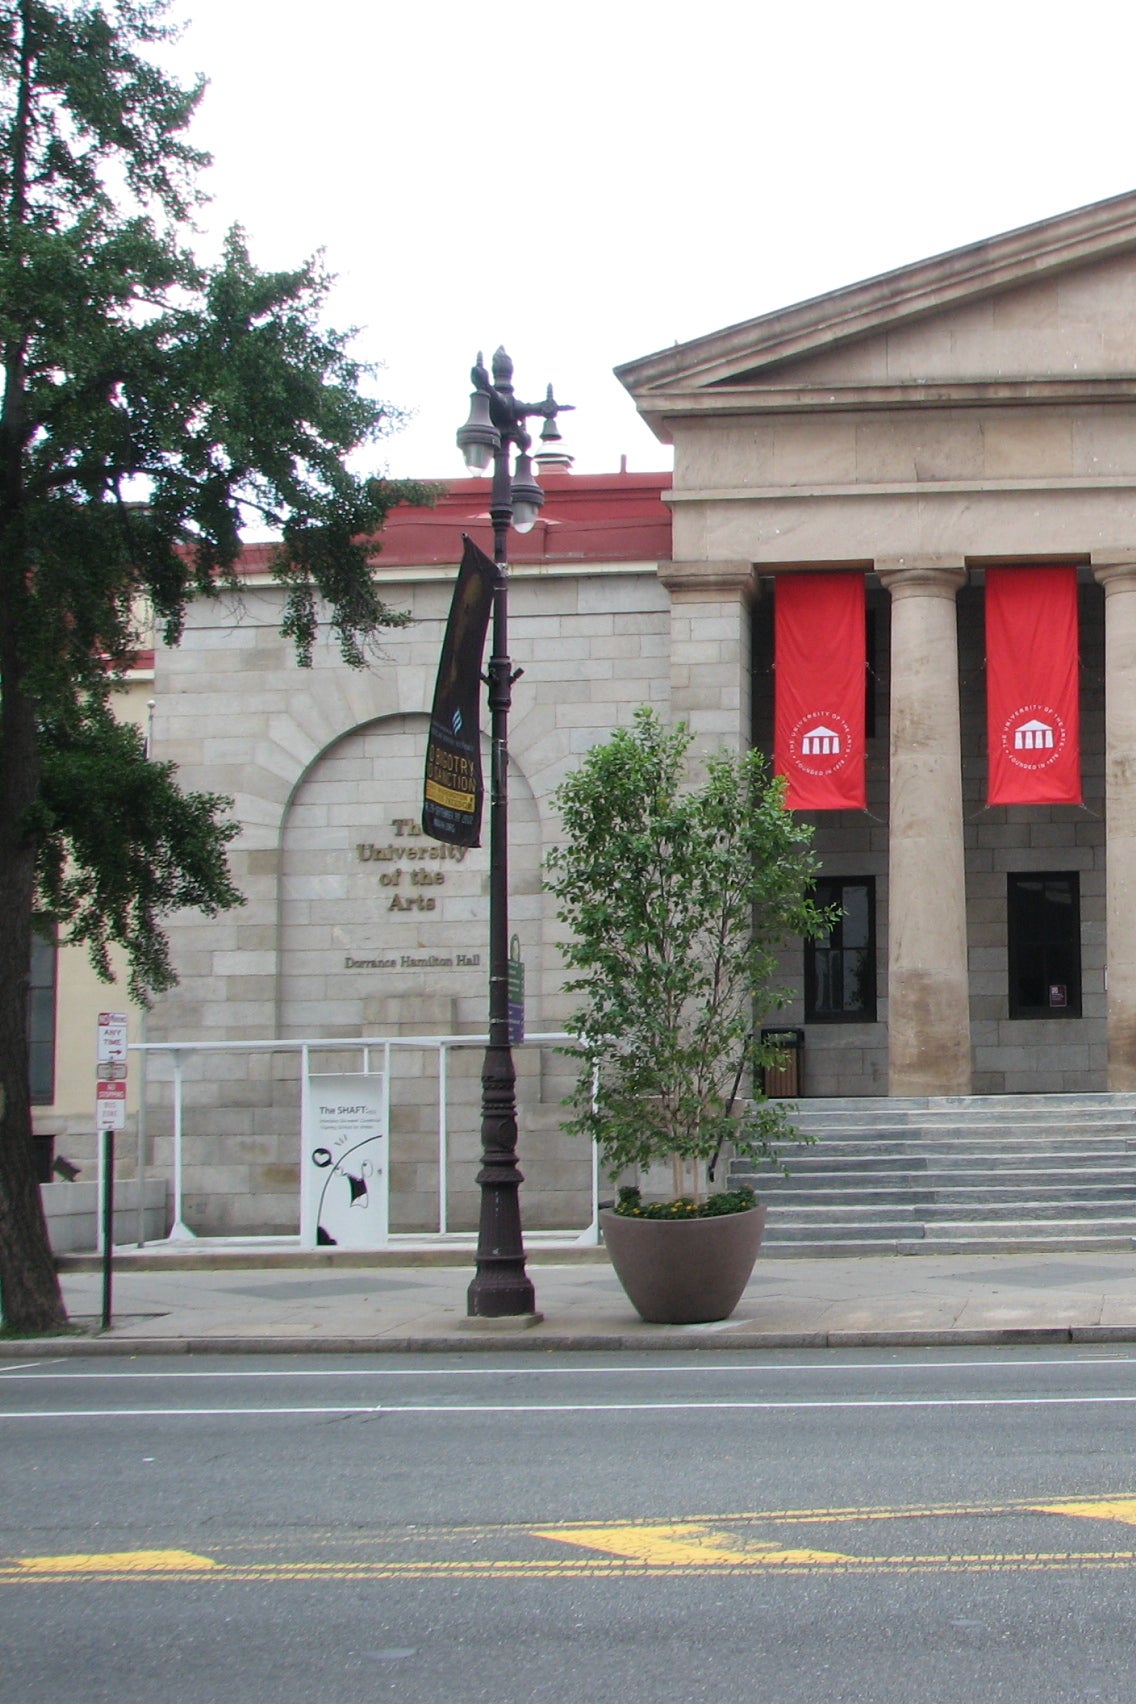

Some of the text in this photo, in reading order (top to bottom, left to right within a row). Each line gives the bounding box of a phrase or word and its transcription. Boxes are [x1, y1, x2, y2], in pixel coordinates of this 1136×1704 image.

[791, 711, 830, 736] UNIVERSITY
[841, 720, 850, 732] THE
[1004, 704, 1042, 732] UNIVERSITY
[1044, 706, 1053, 714] OF
[1053, 714, 1064, 726] THE
[795, 760, 824, 776] FOUNDED
[1008, 754, 1037, 770] FOUNDED
[391, 818, 421, 836] Th
[356, 843, 469, 864] University
[379, 867, 445, 887] of the
[387, 893, 436, 911] Arts
[344, 954, 480, 969] Dorrance Hamilton Hall
[103, 1028, 122, 1036] ANY
[103, 1038, 122, 1046] TIME
[98, 1090, 125, 1098] STOPPING
[107, 1083, 116, 1091] NO
[319, 1106, 336, 1115] The
